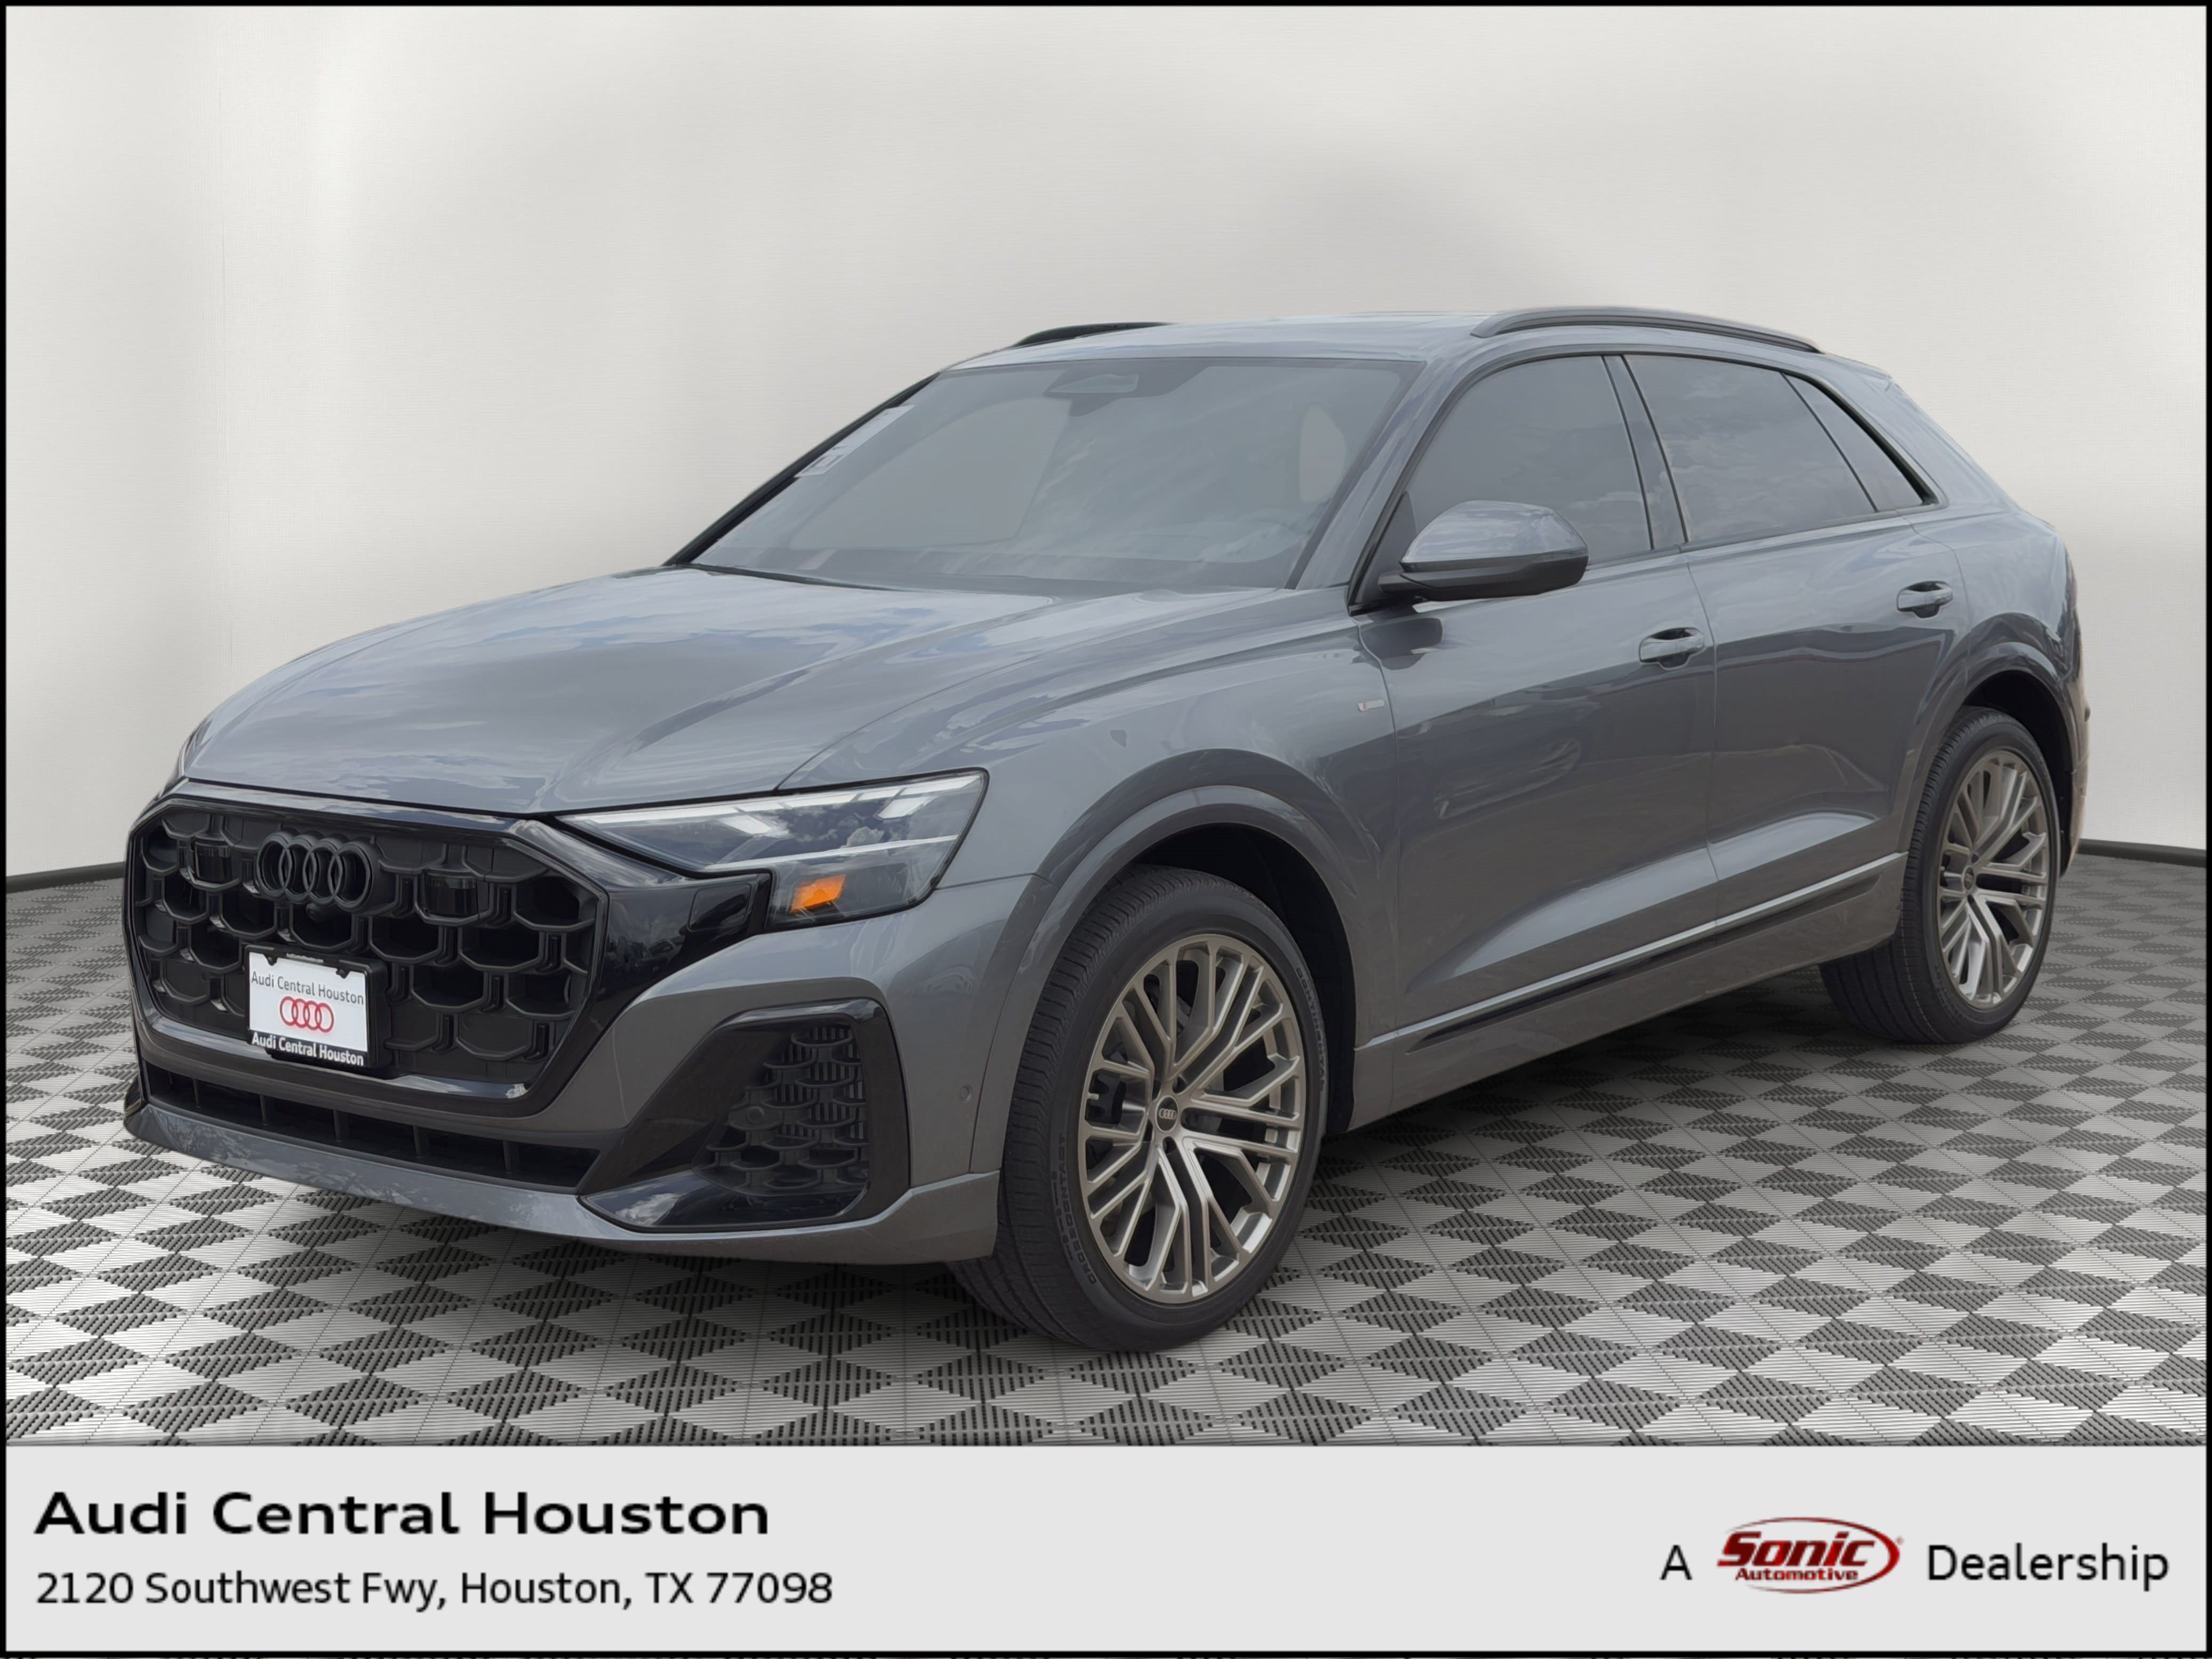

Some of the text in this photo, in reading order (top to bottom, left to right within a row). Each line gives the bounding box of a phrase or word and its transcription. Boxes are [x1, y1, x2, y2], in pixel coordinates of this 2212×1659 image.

[252, 971, 364, 1005] Audi Central Houston
[252, 1032, 364, 1067] Audi Central Houston
